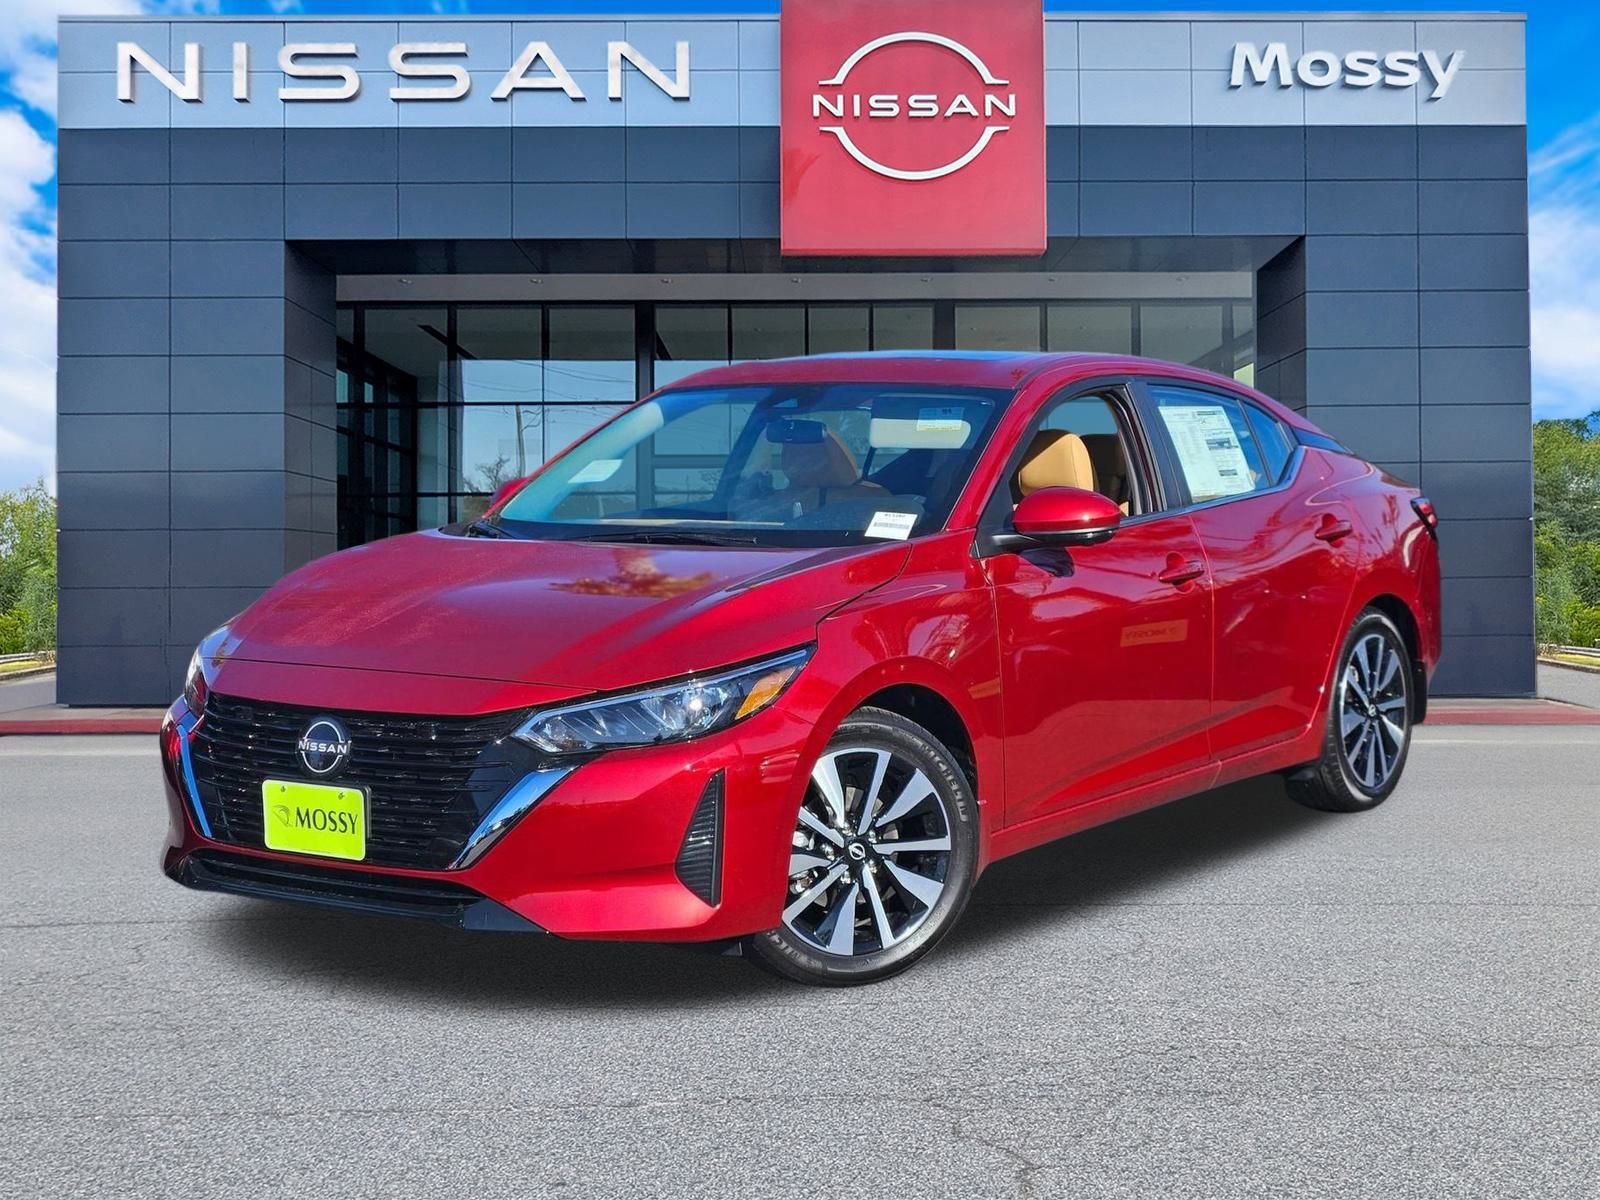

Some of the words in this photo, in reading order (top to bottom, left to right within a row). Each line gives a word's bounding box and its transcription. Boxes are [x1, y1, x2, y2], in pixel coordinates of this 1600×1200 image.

[117, 41, 691, 102] NISSAN
[1229, 42, 1466, 99] Mossy
[812, 94, 1016, 118] NISSAN
[298, 740, 348, 754] NISSAN
[295, 806, 358, 835] MOSSY
